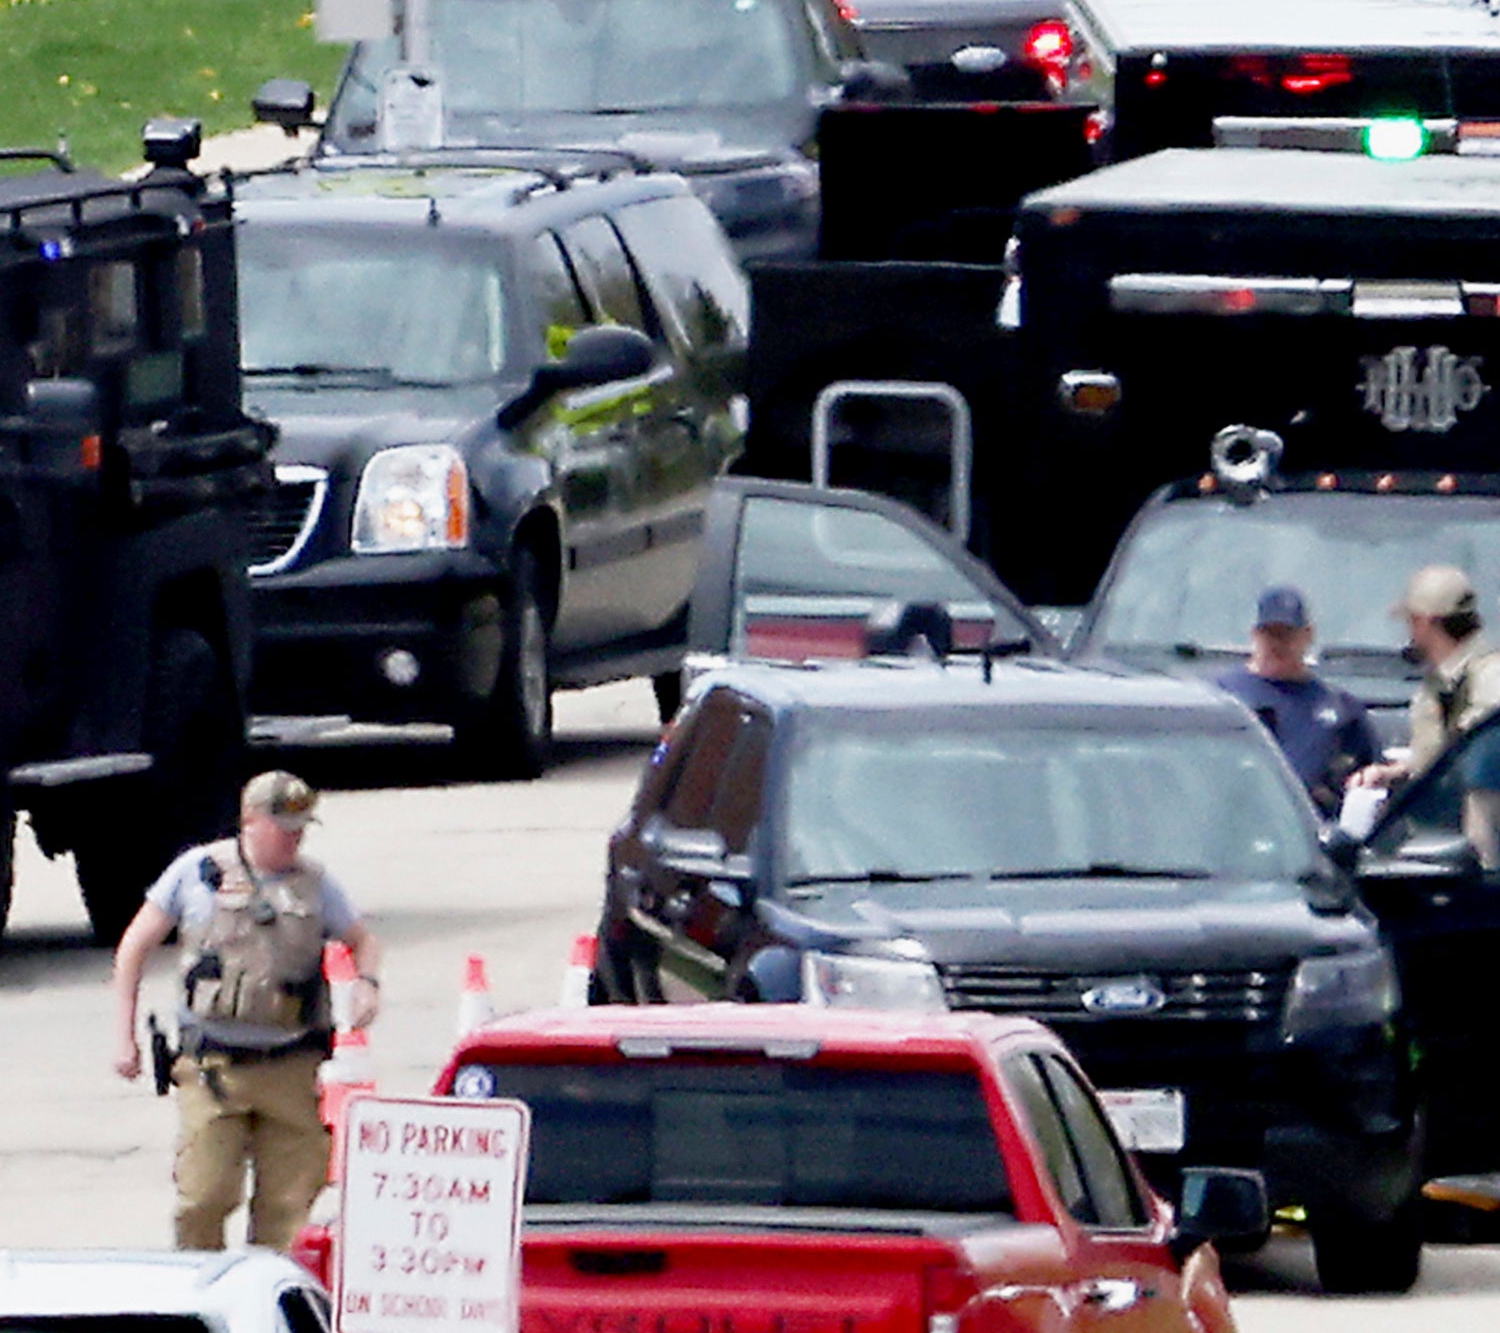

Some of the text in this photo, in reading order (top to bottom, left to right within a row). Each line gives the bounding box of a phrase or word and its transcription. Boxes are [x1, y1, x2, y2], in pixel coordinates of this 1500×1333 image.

[358, 1121, 507, 1160] NO PARKING
[373, 1171, 492, 1203] 7:30AM
[410, 1211, 450, 1242] TO
[371, 1244, 486, 1276] 3:30PM
[346, 1291, 371, 1314] ON
[461, 1298, 504, 1323] DA
